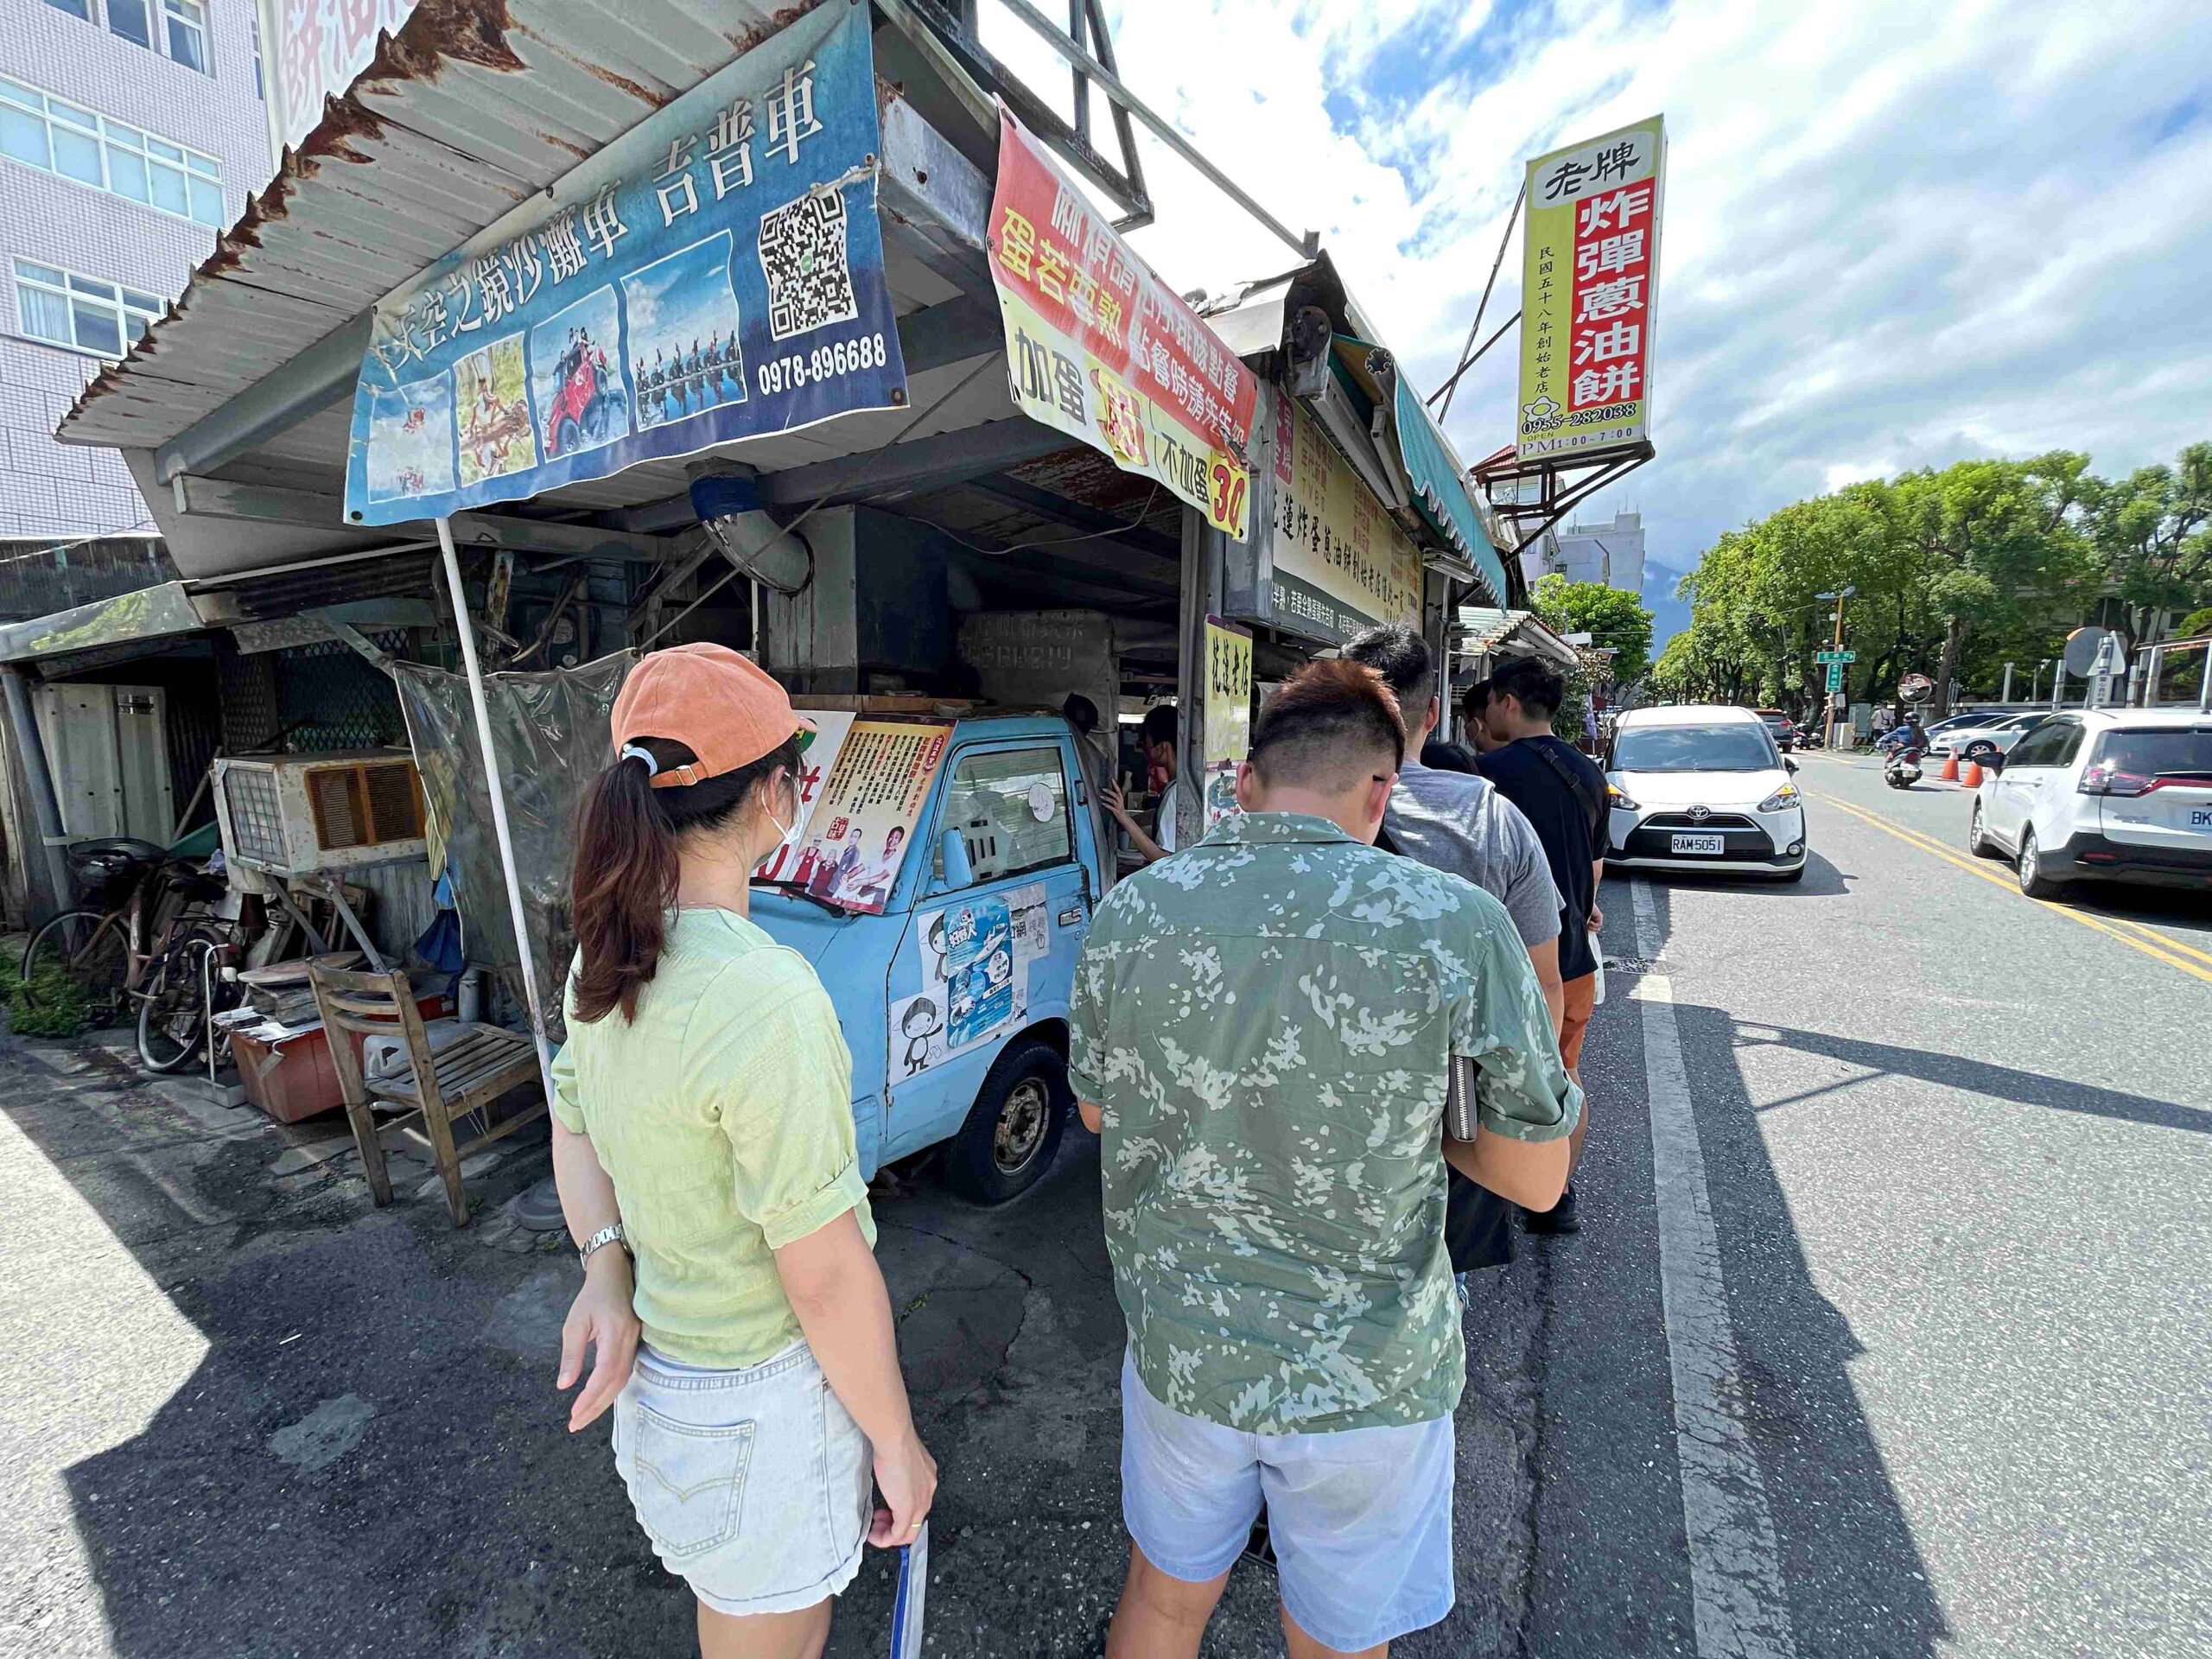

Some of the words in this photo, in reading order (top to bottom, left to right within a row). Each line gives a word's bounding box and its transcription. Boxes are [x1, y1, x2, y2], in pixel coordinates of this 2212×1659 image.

[651, 59, 823, 226] 吉普車
[1545, 143, 1642, 201] 老牌
[999, 207, 1122, 350] 蛋若要熟
[1534, 246, 1554, 394] 民國五十八年創始老店
[759, 332, 887, 396] 0978-896688
[1014, 327, 1086, 426] 加蛋
[1522, 403, 1637, 435] 0955-282038
[1527, 432, 1554, 442] OPEN
[1160, 431, 1211, 505] 不加蛋
[1212, 464, 1245, 531] 30
[1673, 837, 1721, 851] RAM-5051
